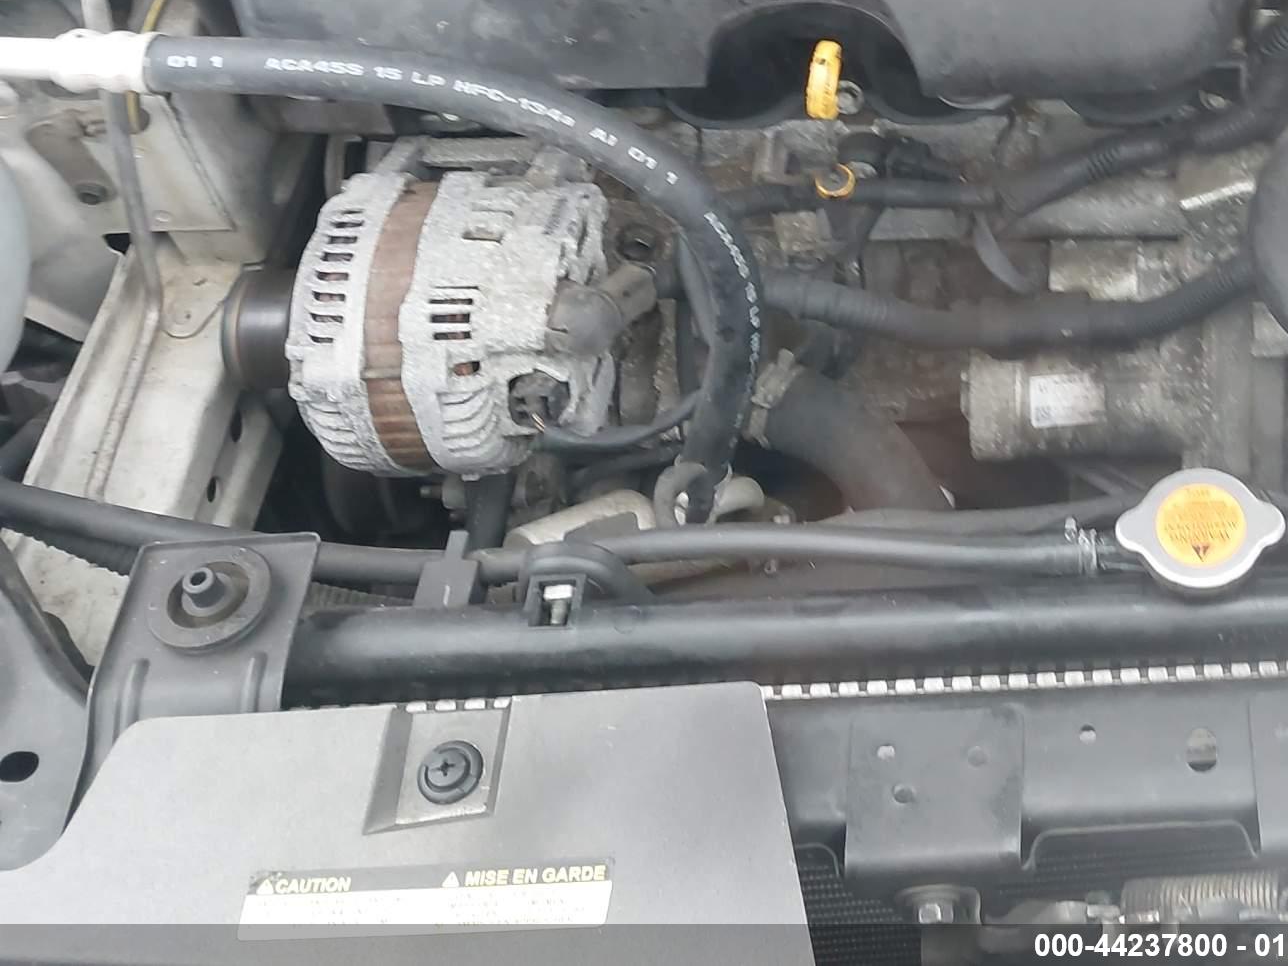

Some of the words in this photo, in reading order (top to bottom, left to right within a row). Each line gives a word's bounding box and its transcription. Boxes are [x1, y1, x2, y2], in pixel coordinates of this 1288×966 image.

[209, 55, 223, 68] 1
[411, 71, 446, 87] LP
[665, 171, 679, 185] 1
[275, 876, 352, 894] CAUTION
[464, 869, 509, 887] MISE
[512, 868, 538, 885] EN
[541, 865, 607, 883] GARDE
